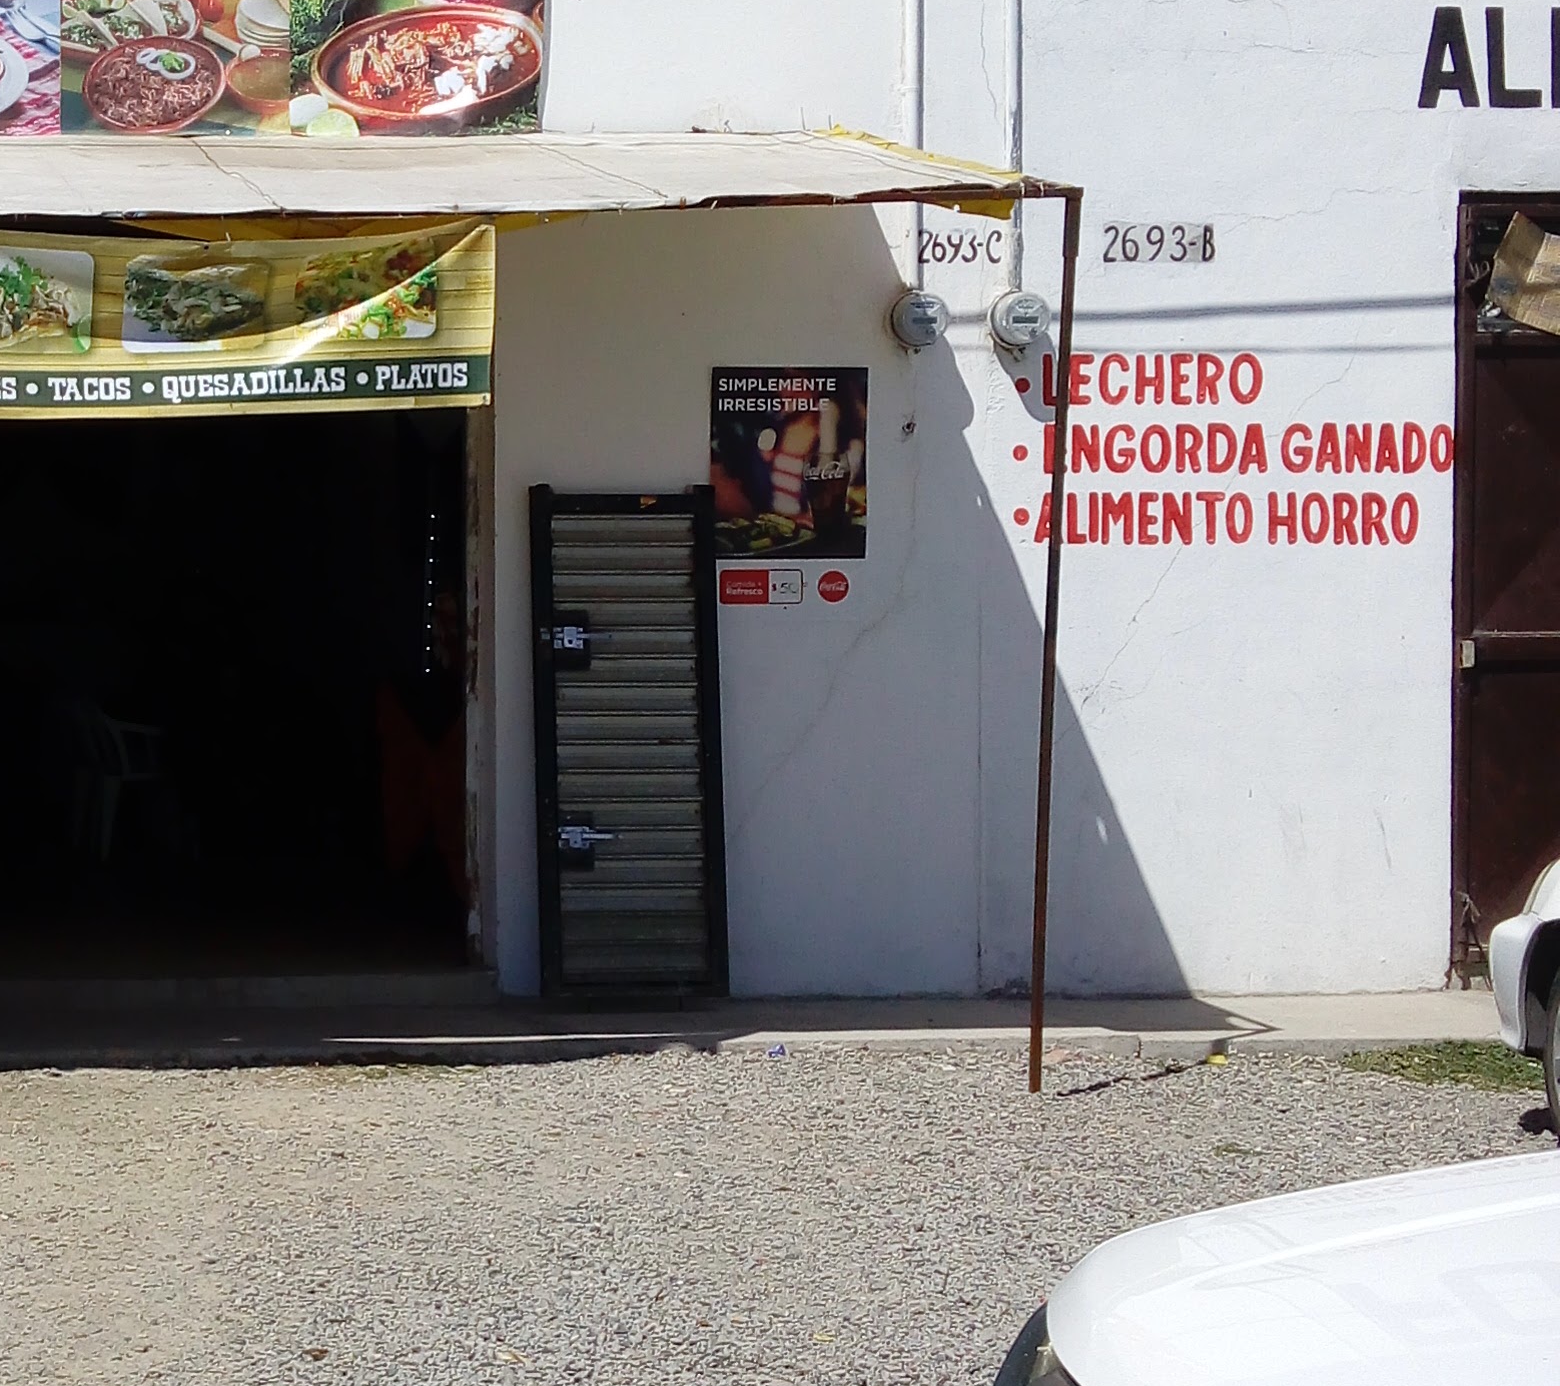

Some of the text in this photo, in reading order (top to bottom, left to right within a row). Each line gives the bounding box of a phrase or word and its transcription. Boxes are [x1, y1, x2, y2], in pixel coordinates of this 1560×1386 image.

[1417, 6, 1560, 109] AL
[1103, 224, 1216, 264] 2693-B
[47, 376, 131, 401] TACOS
[161, 366, 346, 404] QUESADILLAS
[375, 362, 468, 391] PLATOS
[718, 378, 837, 392] SIMPLEMENTE
[1042, 353, 1264, 406] LECHERO
[718, 398, 830, 412] IRRESISTIBLE
[1280, 422, 1454, 475] GANADO
[1033, 491, 1420, 546] ALIMENTO HORRO
